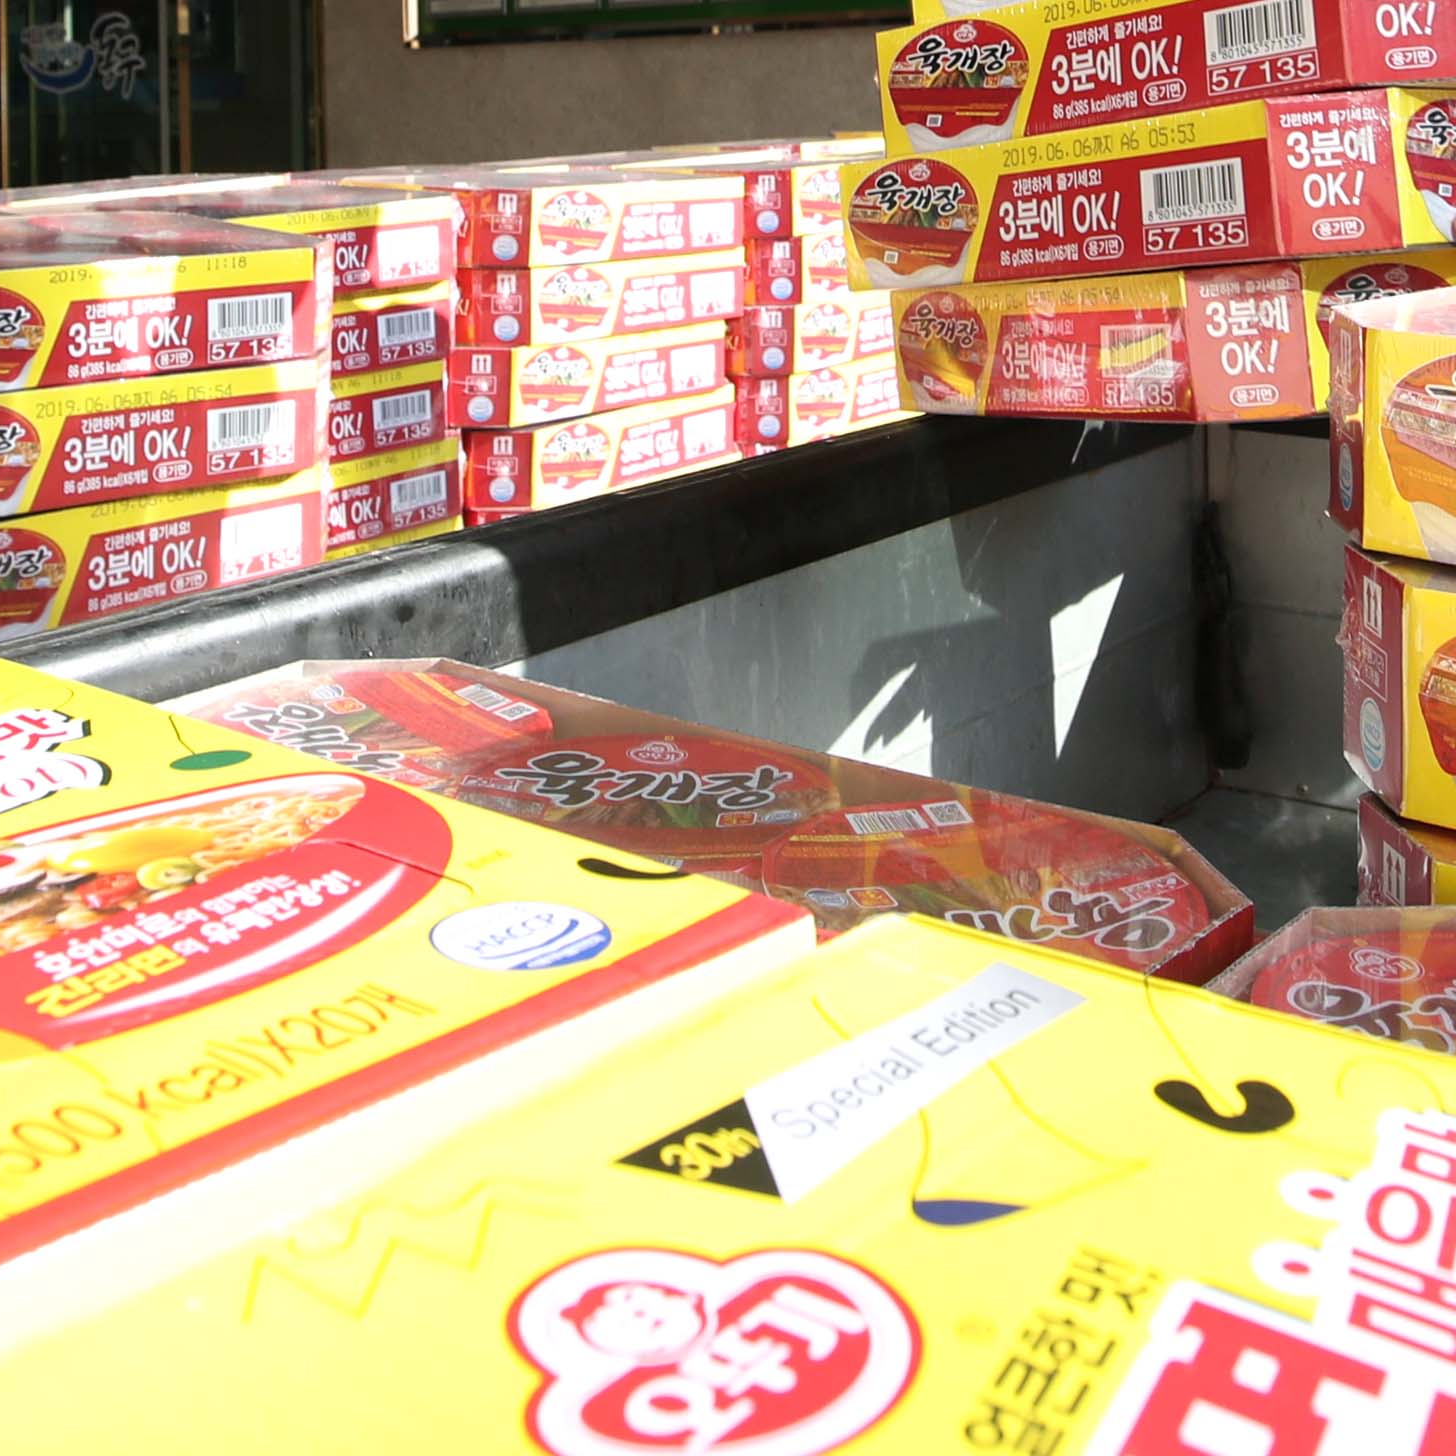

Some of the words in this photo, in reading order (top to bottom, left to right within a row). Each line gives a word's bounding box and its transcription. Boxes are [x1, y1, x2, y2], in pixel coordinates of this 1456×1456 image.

[1066, 25, 1109, 48] 간편하게
[1113, 14, 1163, 35] 즐기세요!
[1376, 4, 1435, 38] OK!
[905, 35, 1015, 76] 육개장
[1051, 46, 1124, 94] 3분에
[1130, 35, 1183, 77] OK!
[1211, 67, 1246, 92] 57
[1258, 53, 1316, 83] 135
[1392, 49, 1429, 67] 용기면
[1146, 82, 1181, 103] 용기면
[1120, 132, 1138, 150] A6
[1148, 124, 1196, 145] 05:53
[1286, 129, 1377, 170] 3분에
[859, 172, 966, 214] 육개장
[1012, 175, 1052, 196] 간편하게
[1056, 168, 1102, 188] 즐기세요!
[1302, 170, 1364, 209] OK!
[998, 195, 1065, 242] 3분에
[1072, 192, 1122, 235] OK!
[1317, 218, 1360, 238] 용기면
[1146, 227, 1185, 251] 57
[1192, 221, 1246, 246] 135
[206, 257, 247, 271] 11:18
[336, 244, 369, 269] OK!
[1205, 297, 1291, 337] 3분에
[68, 319, 139, 358] 3분에
[145, 315, 192, 348] OK!
[212, 344, 240, 361] 57
[337, 328, 368, 354] OK!
[381, 346, 401, 361] 57
[408, 341, 436, 357] 135
[1221, 339, 1279, 376] OK!
[331, 412, 364, 438] OK!
[376, 430, 397, 444] 57
[404, 423, 431, 440] 135
[64, 434, 138, 475] 3분에
[143, 427, 191, 462] OK!
[210, 452, 240, 471] 57
[249, 446, 295, 466] 135
[351, 493, 382, 523] OK!
[88, 545, 154, 591] 3분에
[162, 537, 206, 574] OK!
[658, 1124, 764, 1182] 30th
[771, 1046, 926, 1140] Special
[911, 982, 1042, 1058] Edition
[622, 1283, 870, 1438] 오뚜기
